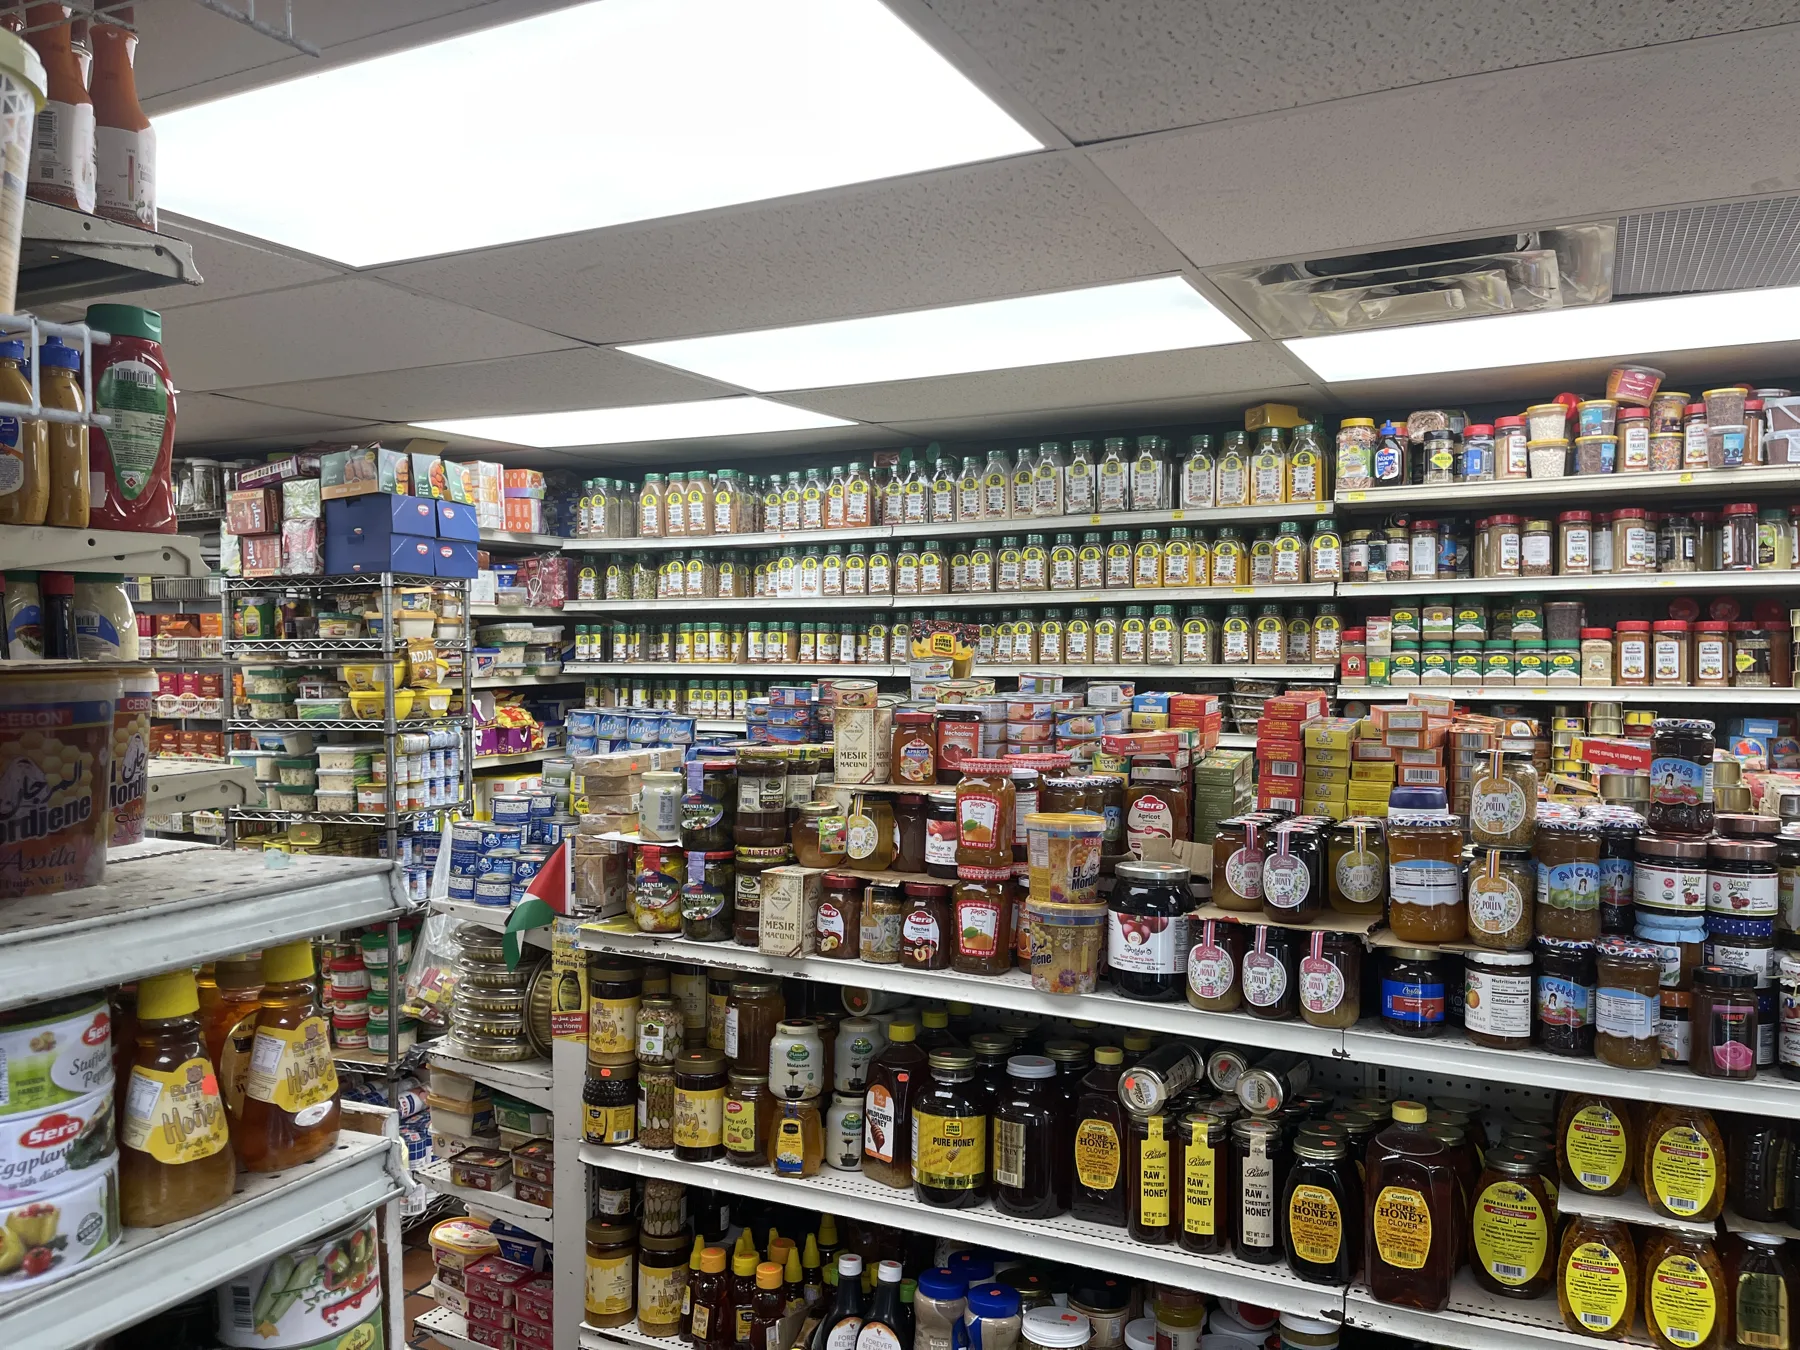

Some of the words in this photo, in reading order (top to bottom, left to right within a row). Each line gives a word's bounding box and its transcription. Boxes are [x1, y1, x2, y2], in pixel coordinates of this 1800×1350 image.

[1136, 801, 1165, 811] Sera
[1137, 813, 1161, 821] Apricot
[1274, 877, 1292, 887] HONEY
[819, 907, 838, 917] Sera
[910, 915, 934, 924] Sera
[555, 958, 578, 968] Healing
[563, 1023, 583, 1031] Honey
[28, 1120, 80, 1145] Sera
[932, 1137, 951, 1147] PURE
[952, 1137, 975, 1148] HONEY
[1080, 1138, 1117, 1150] HONEY
[1143, 1170, 1160, 1180] RAW
[1187, 1177, 1204, 1188] RAW
[1143, 1188, 1168, 1198] HONEY
[1245, 1188, 1263, 1199] RAW
[1187, 1196, 1212, 1206] HONEY
[1301, 1200, 1327, 1211] PURE
[1245, 1206, 1272, 1218] HONEY
[1293, 1204, 1337, 1221] HONEY
[1389, 1202, 1416, 1213] PURE
[1293, 1214, 1338, 1228] WILDFLOWER
[1379, 1207, 1427, 1224] HONEY
[1387, 1219, 1418, 1230] CLOVER
[865, 1337, 893, 1350] FOREVER
